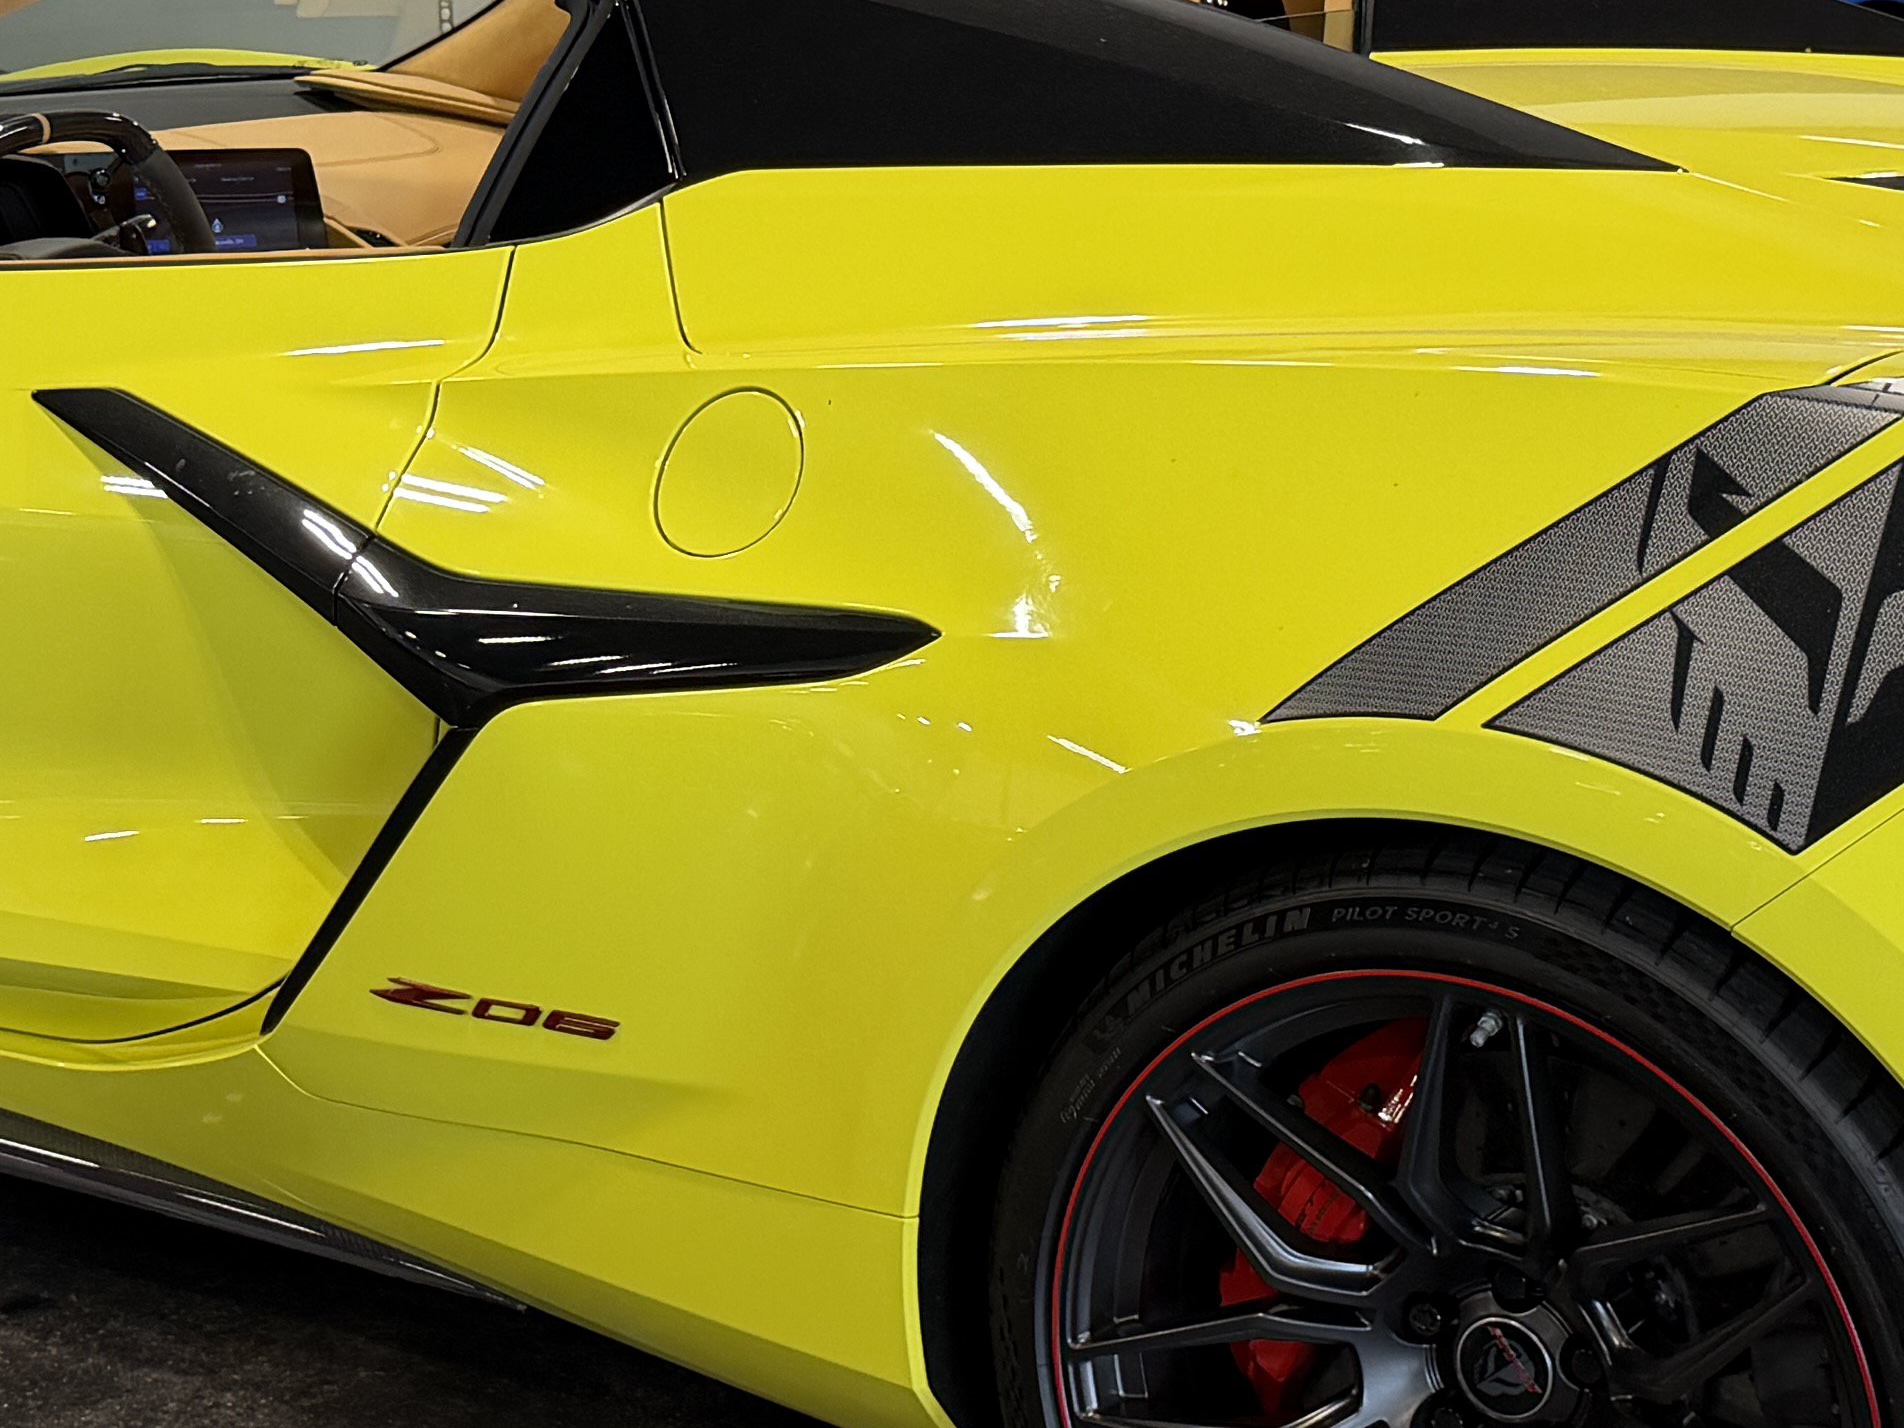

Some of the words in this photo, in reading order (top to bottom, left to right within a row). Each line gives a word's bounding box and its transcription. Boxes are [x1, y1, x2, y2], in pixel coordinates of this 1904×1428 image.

[1331, 905, 1399, 923] PILOT
[1405, 907, 1487, 931] SPORT
[1505, 925, 1520, 940] S
[1126, 907, 1310, 1015] MICHELIN
[368, 977, 622, 1041] Z06
